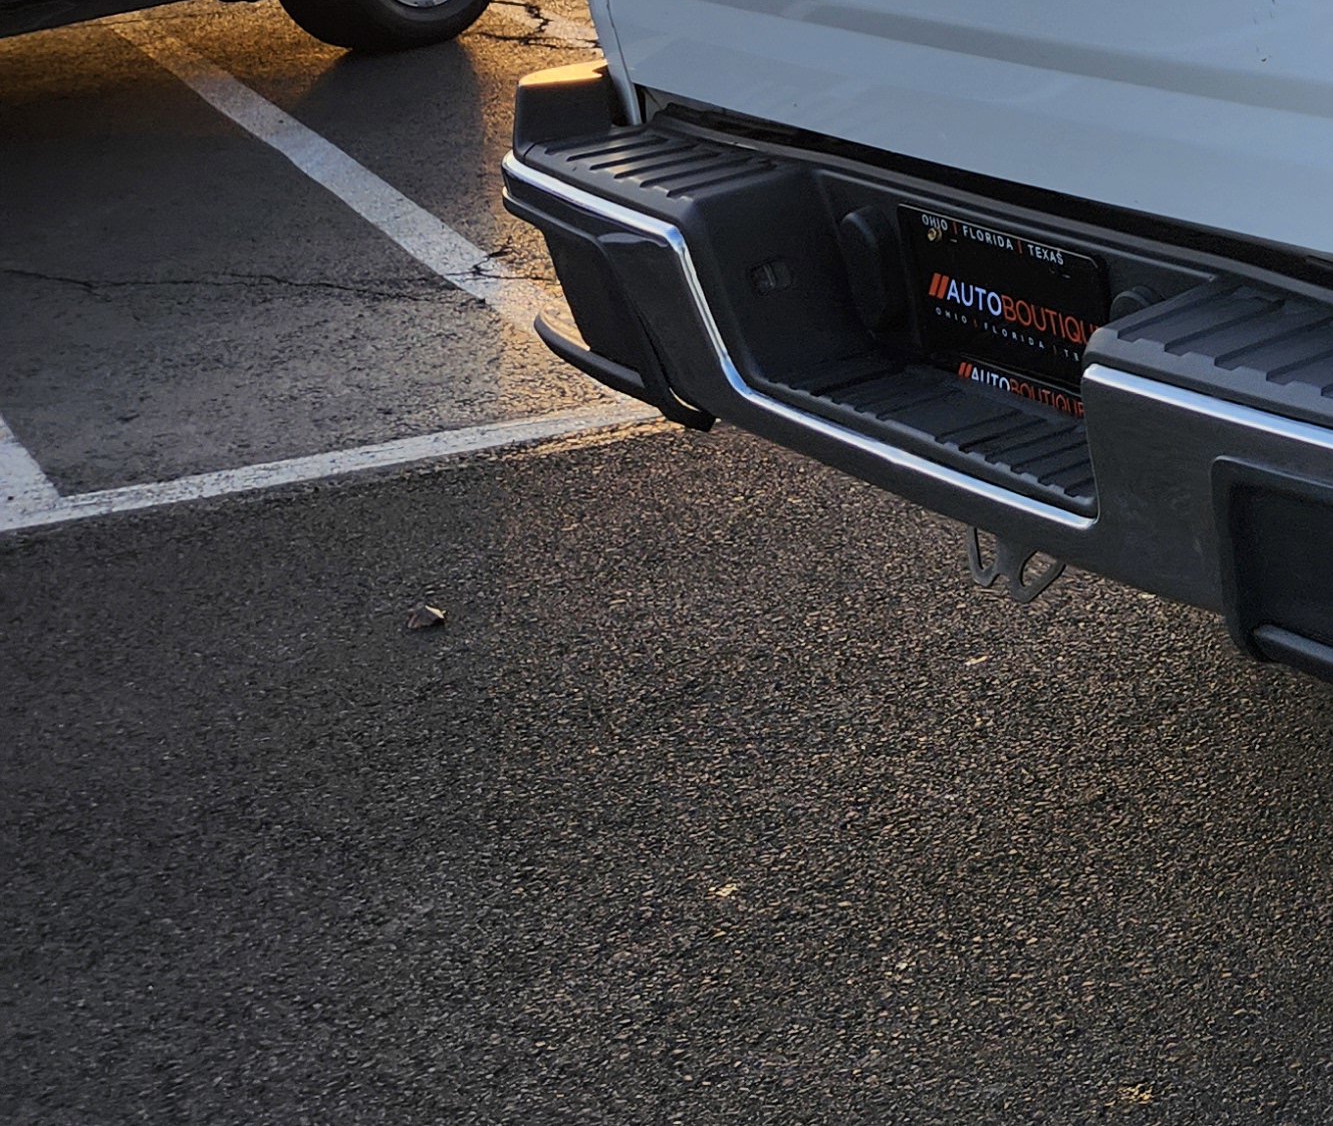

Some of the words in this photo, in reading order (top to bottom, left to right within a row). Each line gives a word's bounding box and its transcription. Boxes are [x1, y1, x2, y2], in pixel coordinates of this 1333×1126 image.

[921, 213, 948, 232] OHIO
[963, 225, 1014, 251] FLORIDA
[1027, 243, 1065, 266] TEXAS
[935, 306, 968, 324] OHIO
[984, 322, 1045, 349] FLORIDA
[946, 278, 1098, 345] AUTOBOUTIQU
